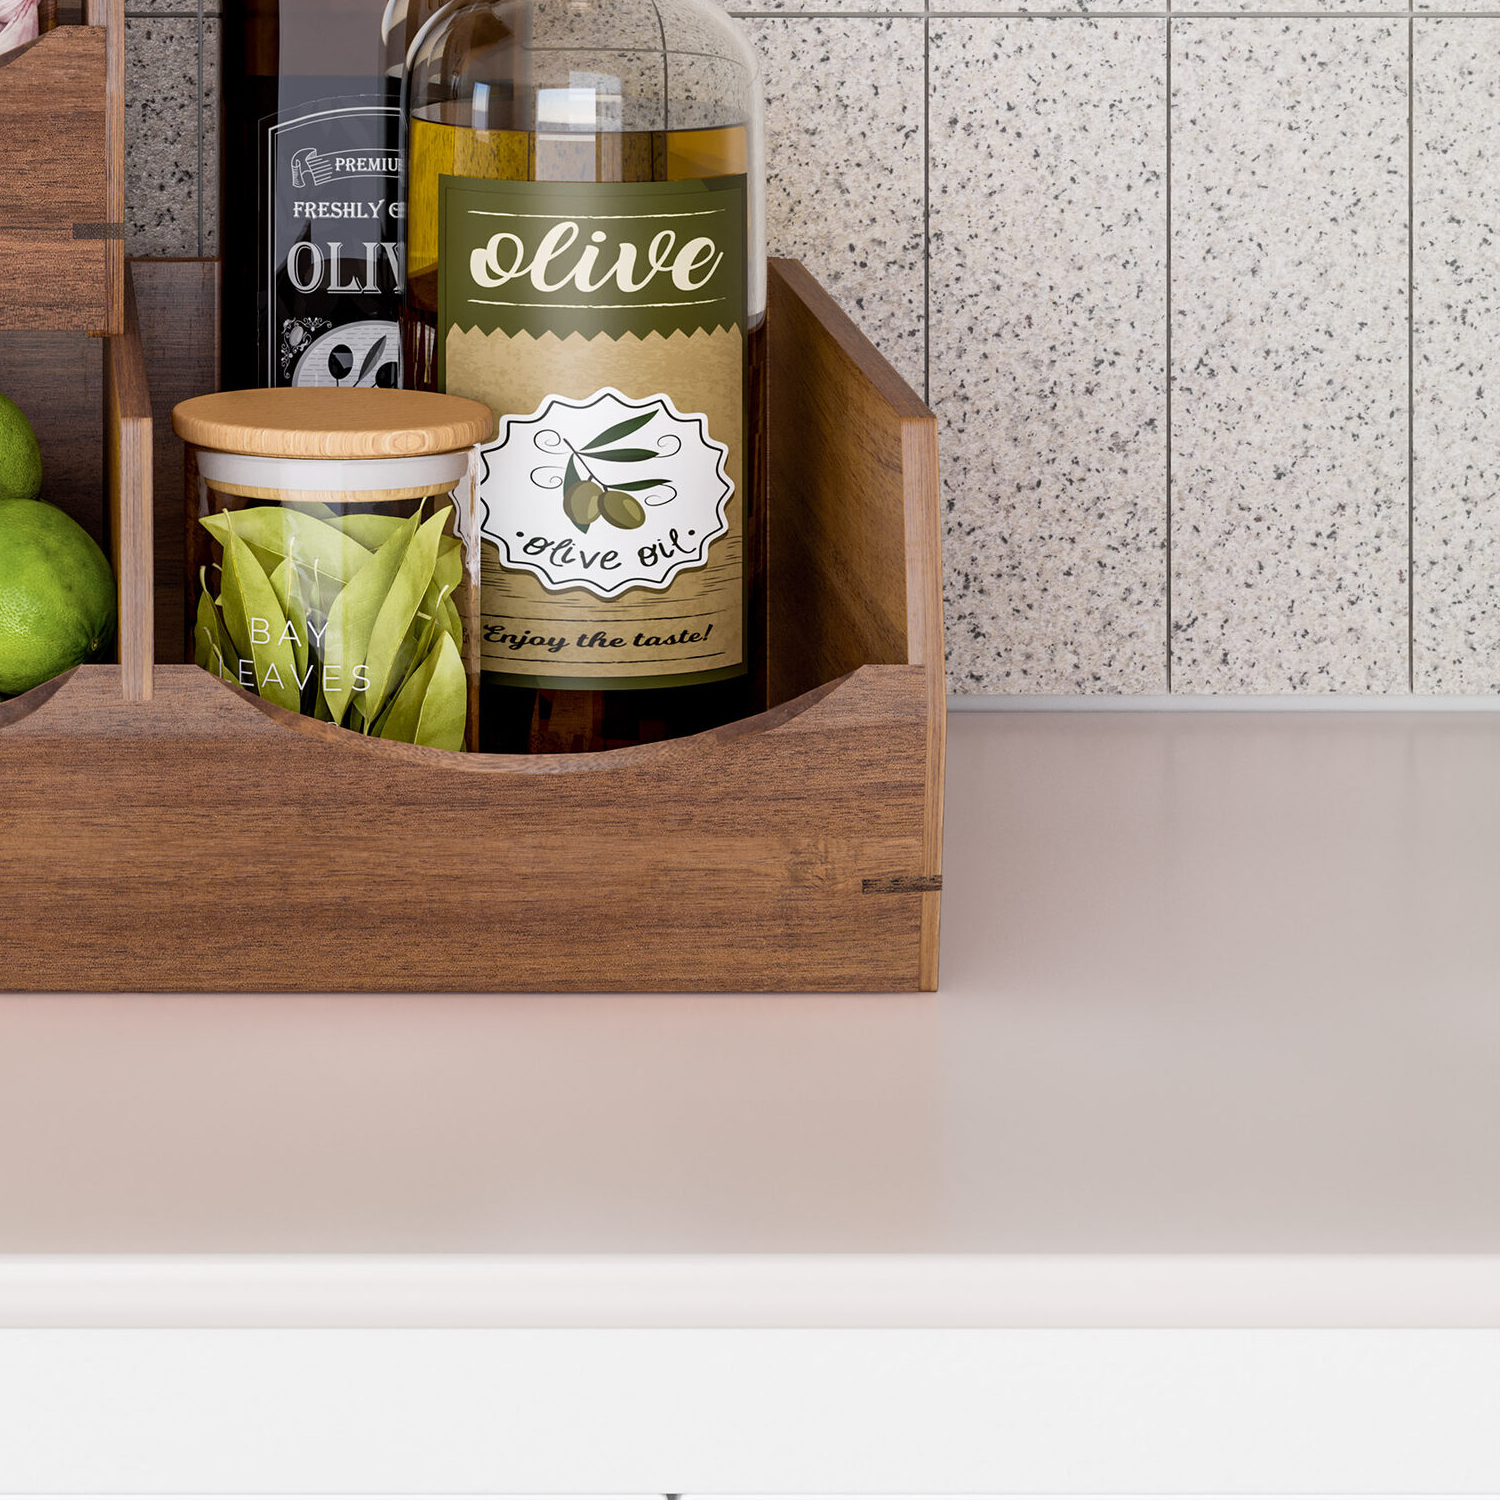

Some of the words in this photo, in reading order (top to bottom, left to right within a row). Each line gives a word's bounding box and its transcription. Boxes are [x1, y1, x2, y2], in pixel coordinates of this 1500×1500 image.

[293, 199, 386, 219] FRESHLY
[468, 220, 725, 292] olive
[522, 536, 622, 570] olive
[638, 528, 697, 567] oil
[251, 617, 330, 648] BAY
[483, 624, 569, 653] Enjoy
[576, 631, 629, 648] the
[632, 624, 714, 647] taste!
